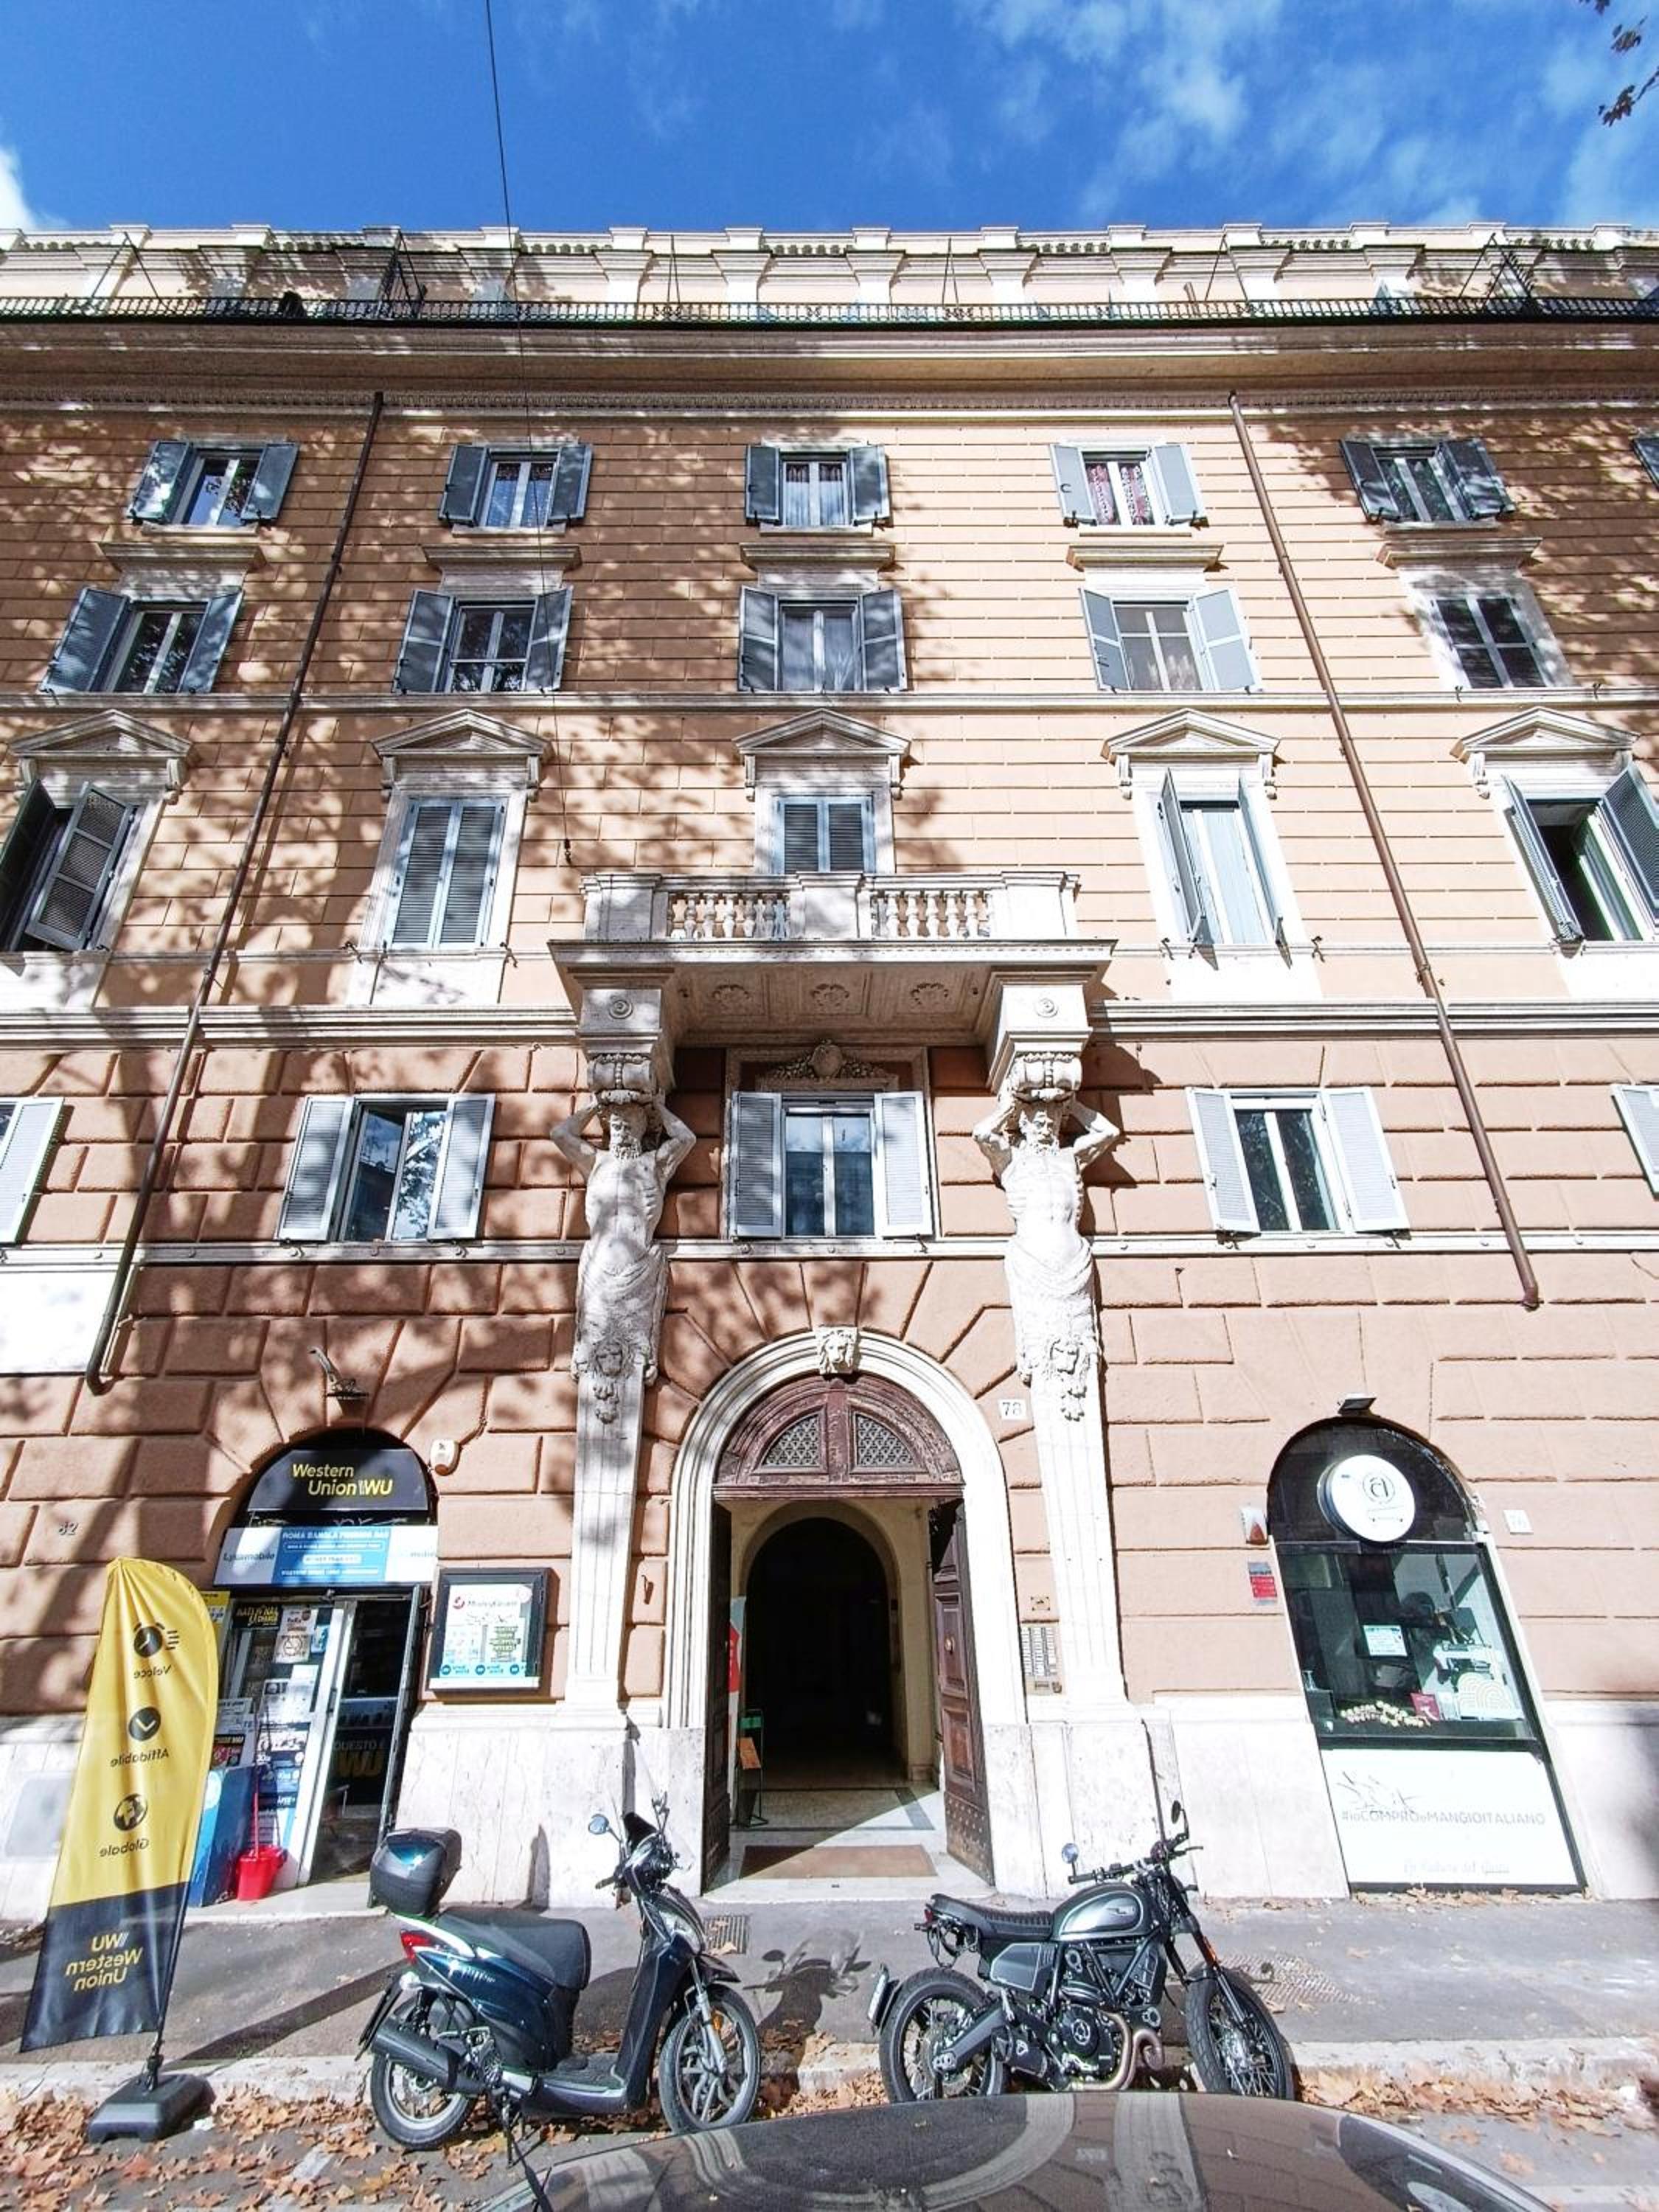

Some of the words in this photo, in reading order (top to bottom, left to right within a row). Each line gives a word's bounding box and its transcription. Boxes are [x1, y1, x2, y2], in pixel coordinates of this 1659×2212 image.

[292, 1464, 355, 1478] Western
[307, 1481, 357, 1495] Union
[58, 1522, 80, 1536] 82
